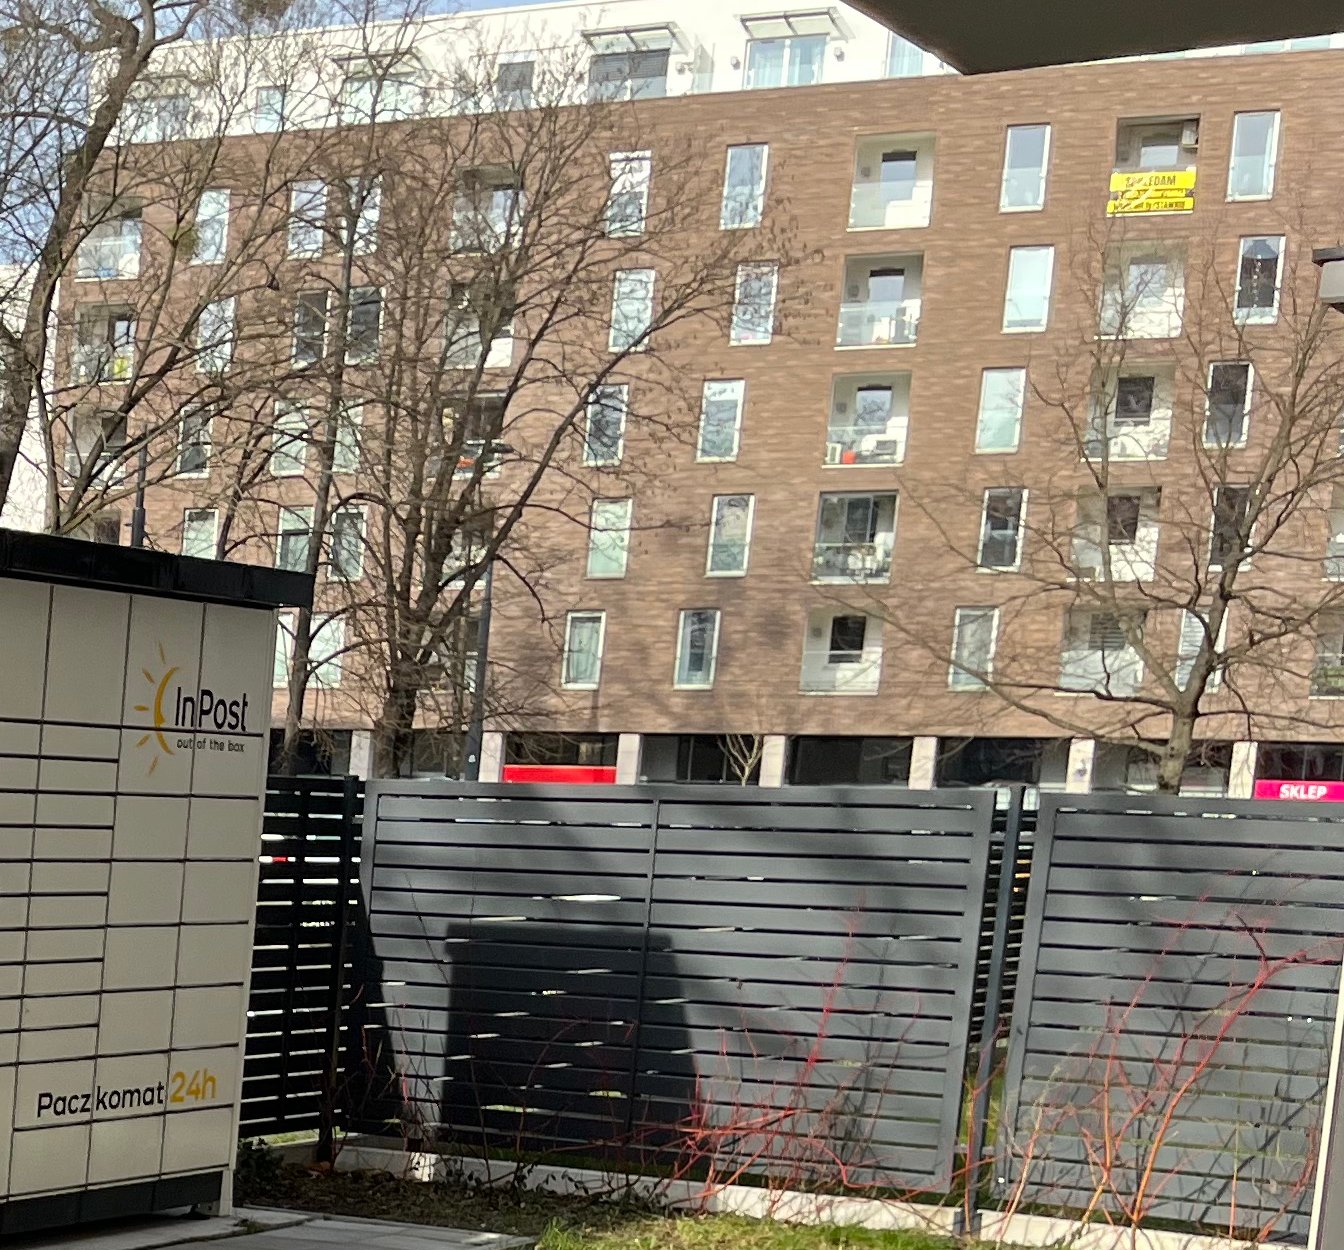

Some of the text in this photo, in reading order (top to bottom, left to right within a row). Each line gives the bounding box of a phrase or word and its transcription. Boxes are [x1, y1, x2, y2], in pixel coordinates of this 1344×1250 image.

[174, 686, 249, 732] InPost
[176, 737, 245, 753] out of the box
[1279, 784, 1328, 799] SKLEP
[36, 1068, 218, 1118] Paczkomat 24h
